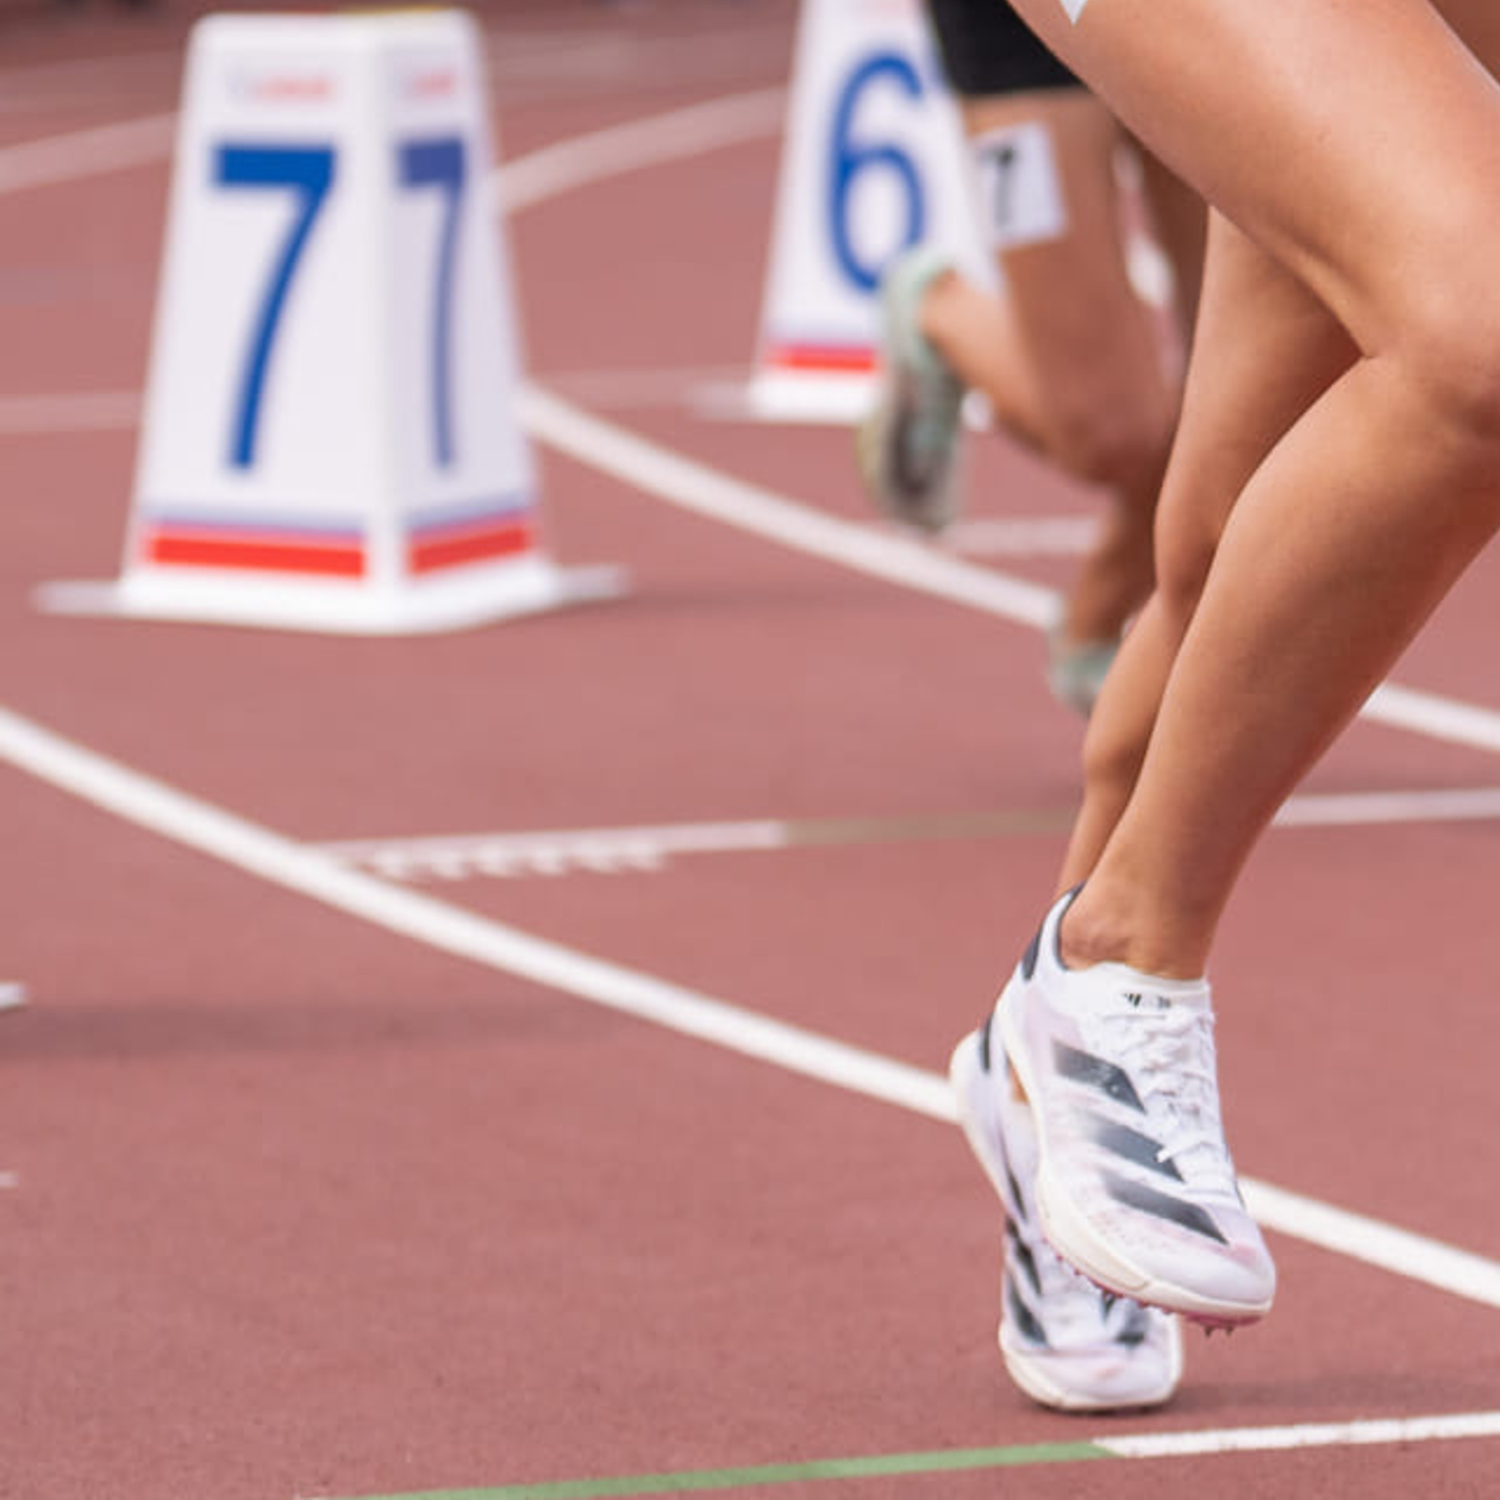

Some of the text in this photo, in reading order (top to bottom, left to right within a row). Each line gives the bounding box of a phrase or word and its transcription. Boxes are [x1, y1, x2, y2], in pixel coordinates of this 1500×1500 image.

[212, 136, 467, 472] 7 7
[828, 52, 925, 296] 6
